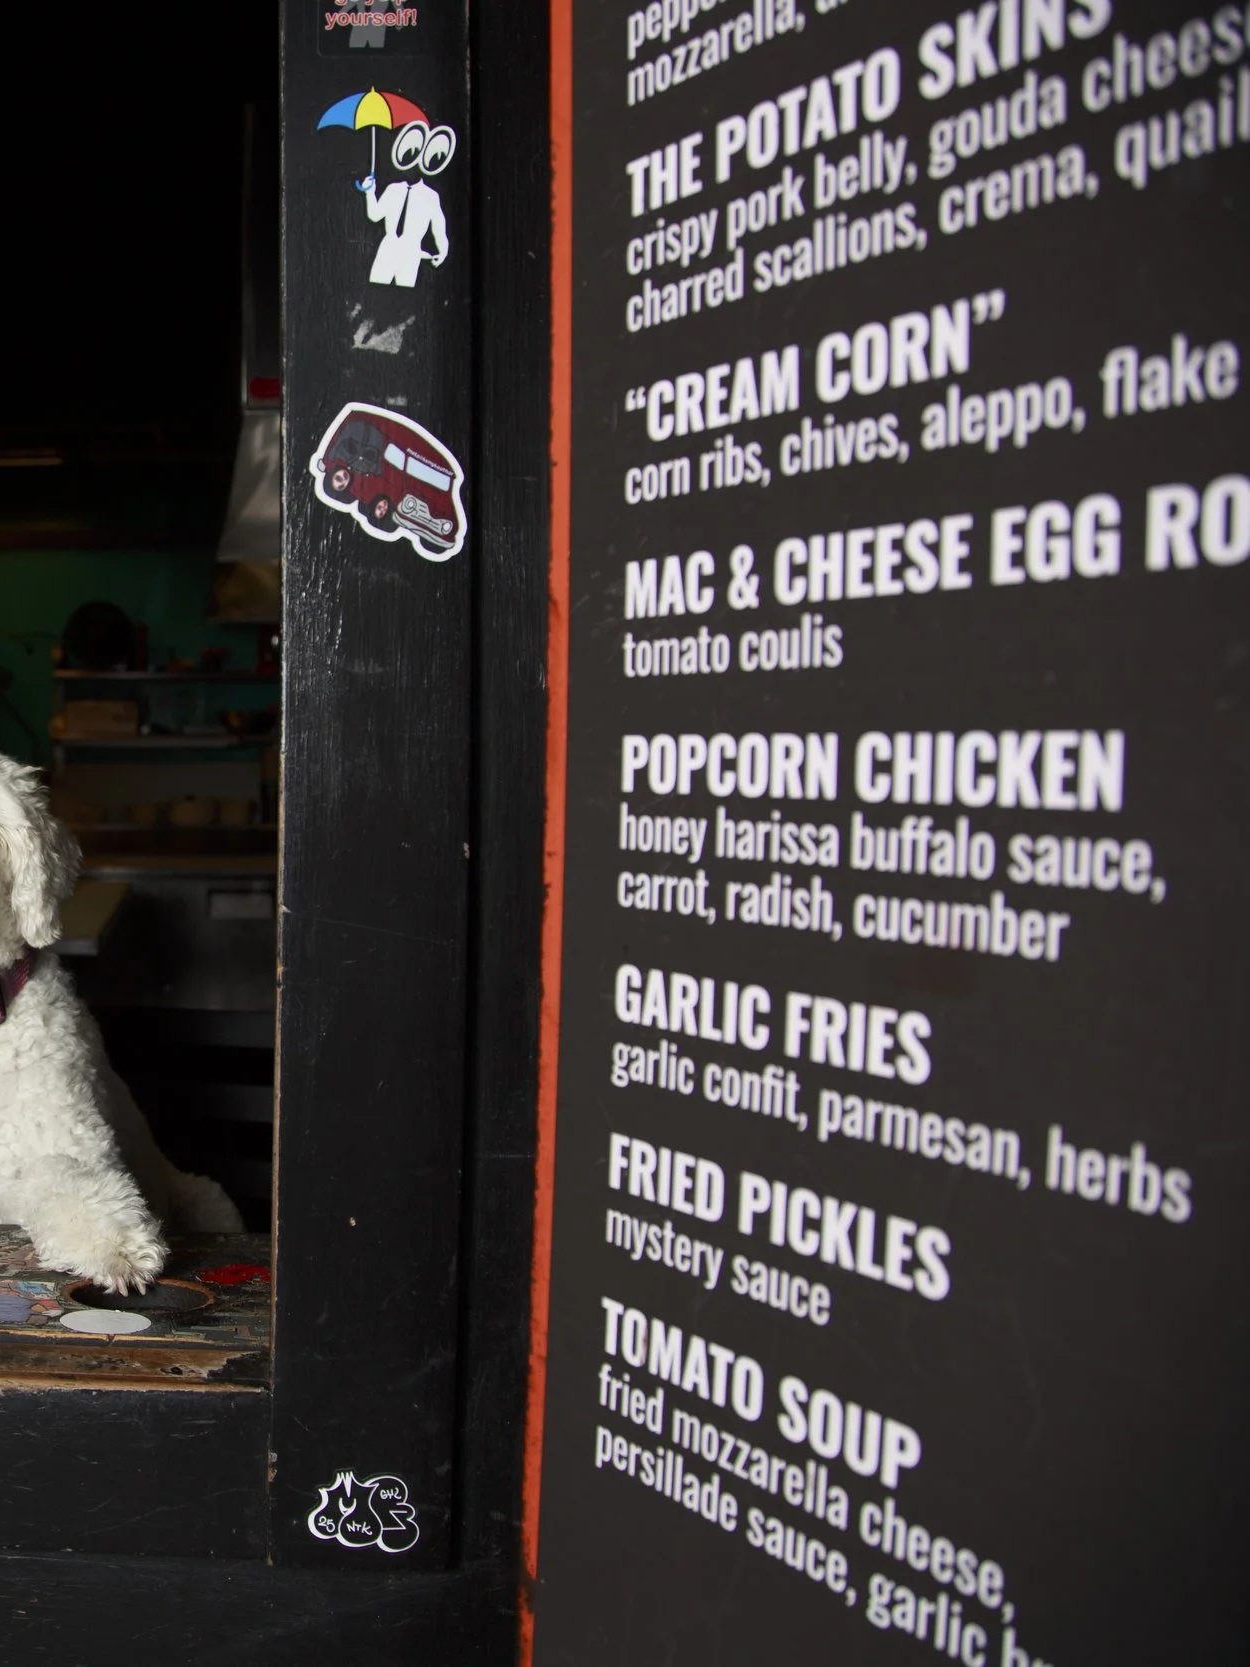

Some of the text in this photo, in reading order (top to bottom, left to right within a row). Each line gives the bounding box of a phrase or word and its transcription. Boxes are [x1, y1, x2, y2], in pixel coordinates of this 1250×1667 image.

[324, 8, 418, 31] yourself!
[627, 0, 806, 106] mozzarella,
[626, 131, 703, 218] THE
[715, 47, 901, 183] POTATO
[626, 3, 1250, 276] crispy pork belly, gouda chees
[626, 247, 744, 334] charred
[753, 200, 927, 293] scallions,
[938, 143, 1099, 235] crema,
[625, 288, 1007, 442] “CREAM CORN”
[625, 333, 1240, 504] corn ribs, chives, aleppo, flake
[624, 473, 1250, 620] MAC & CHEESE EGG RO
[622, 613, 844, 678] tomato coulis
[621, 728, 1125, 813] POPCORN CHICKEN
[617, 870, 1070, 962] carrot, radish, cucumber
[619, 802, 1167, 904] honey harissa buffalo sauce,
[614, 964, 932, 1086] GARLIC FRIES
[610, 1040, 1192, 1224] garlic confit, parmesan, herbs
[605, 1208, 832, 1327] mystery sauce
[608, 1131, 951, 1302] FRIED PICKLES
[601, 1296, 922, 1490] TOMATO SOUP
[317, 1515, 373, 1536] 25 NTK
[595, 1425, 987, 1667] persillade sauce, garlic
[598, 1363, 1014, 1624] fried mozzarella cheese,
